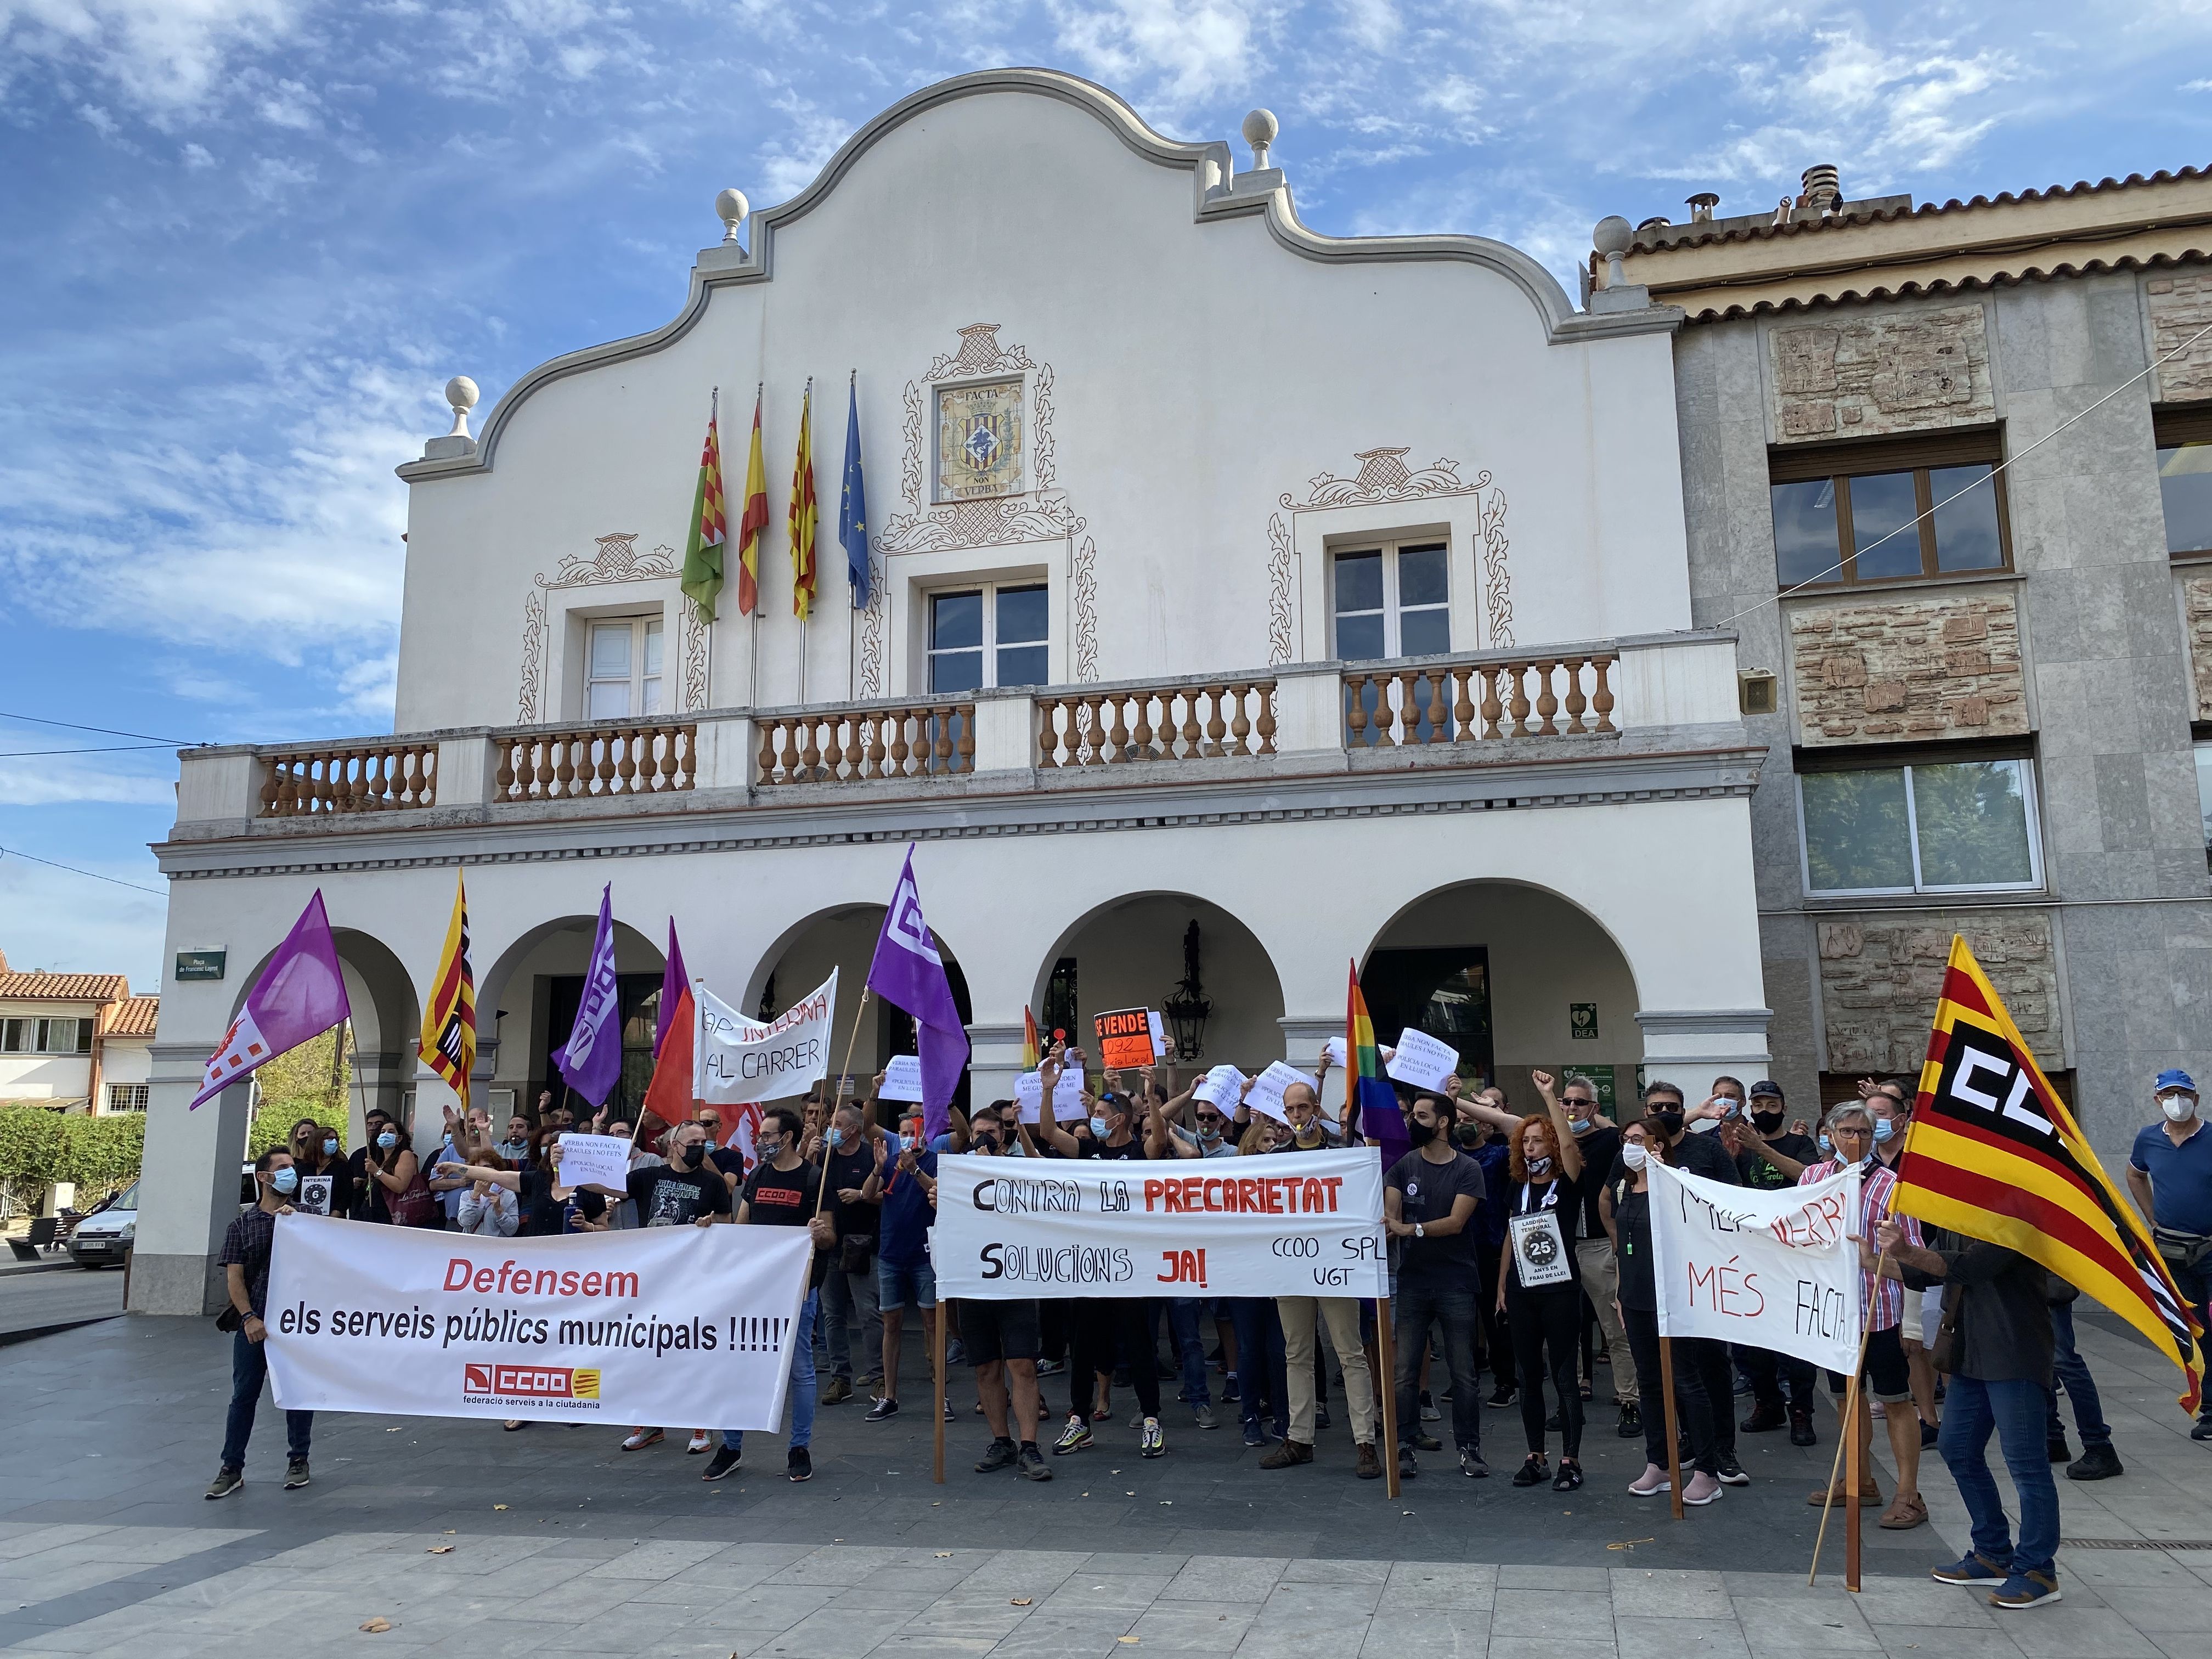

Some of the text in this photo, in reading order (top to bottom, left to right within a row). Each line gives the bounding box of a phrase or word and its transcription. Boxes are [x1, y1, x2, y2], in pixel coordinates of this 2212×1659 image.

[965, 389, 999, 401] FACTA
[964, 485, 998, 496] VERBA
[702, 994, 827, 1042] CAP INTERINA
[1096, 1019, 1103, 1037] SE
[1104, 1013, 1147, 1035] VENDE
[1108, 1038, 1133, 1054] 092
[1417, 1038, 1430, 1046] NON
[1431, 1043, 1451, 1056] FACTA
[706, 1039, 820, 1079] AL CARRER
[1126, 1053, 1149, 1064] Local
[1409, 1065, 1430, 1076] LLUITA
[1421, 1061, 1441, 1072] LOCAL
[1284, 1073, 1294, 1081] NON
[589, 1169, 607, 1177] LLUITA
[654, 1186, 700, 1200] ESCAPE
[658, 1180, 701, 1193] THE GREAT
[312, 1190, 319, 1199] 6
[758, 1190, 786, 1199] CCOO
[973, 1178, 1081, 1213] CONTRA
[1100, 1180, 1130, 1212] LA
[1521, 1224, 1551, 1233] TEMPORAL
[1522, 1218, 1548, 1226] LABORAL
[1272, 1237, 1386, 1260] CCOO SPL
[1530, 1241, 1551, 1256] 25
[1157, 1248, 1207, 1288] JA!
[443, 1258, 638, 1297] Defensem
[1313, 1267, 1356, 1286] UGT
[1689, 1255, 1764, 1317] MÉS
[1796, 1279, 1845, 1344] FACTA
[279, 1301, 321, 1335] els
[330, 1305, 435, 1339] serveis
[442, 1307, 549, 1348] públics
[559, 1313, 717, 1358] municipals
[499, 1370, 566, 1391] CCOO
[463, 1396, 503, 1405] federació
[556, 1400, 600, 1409] ciutadania
